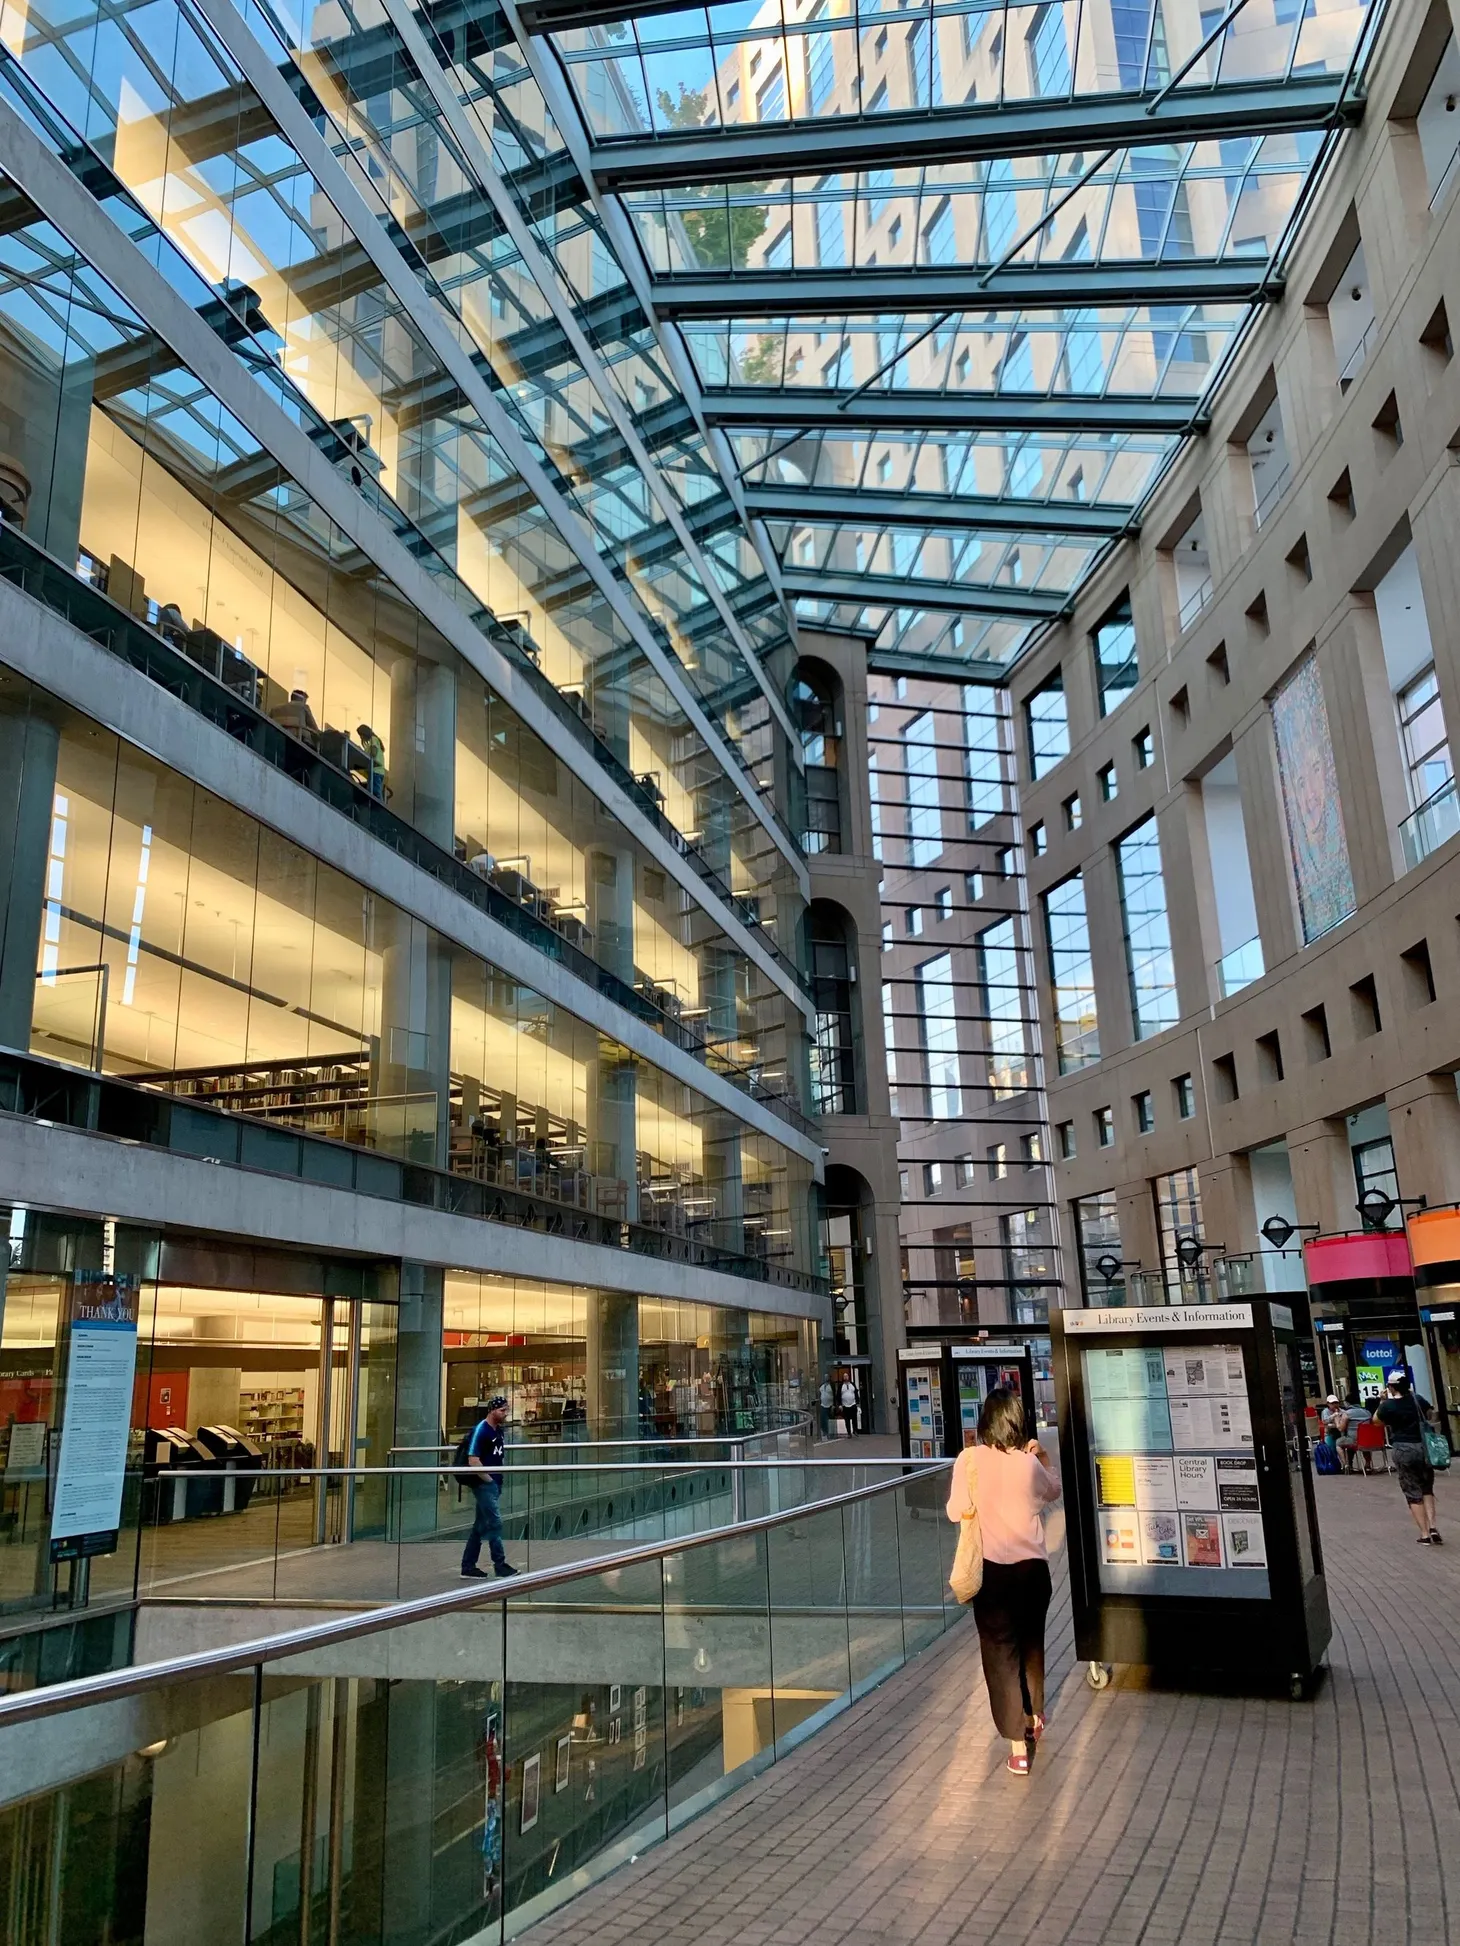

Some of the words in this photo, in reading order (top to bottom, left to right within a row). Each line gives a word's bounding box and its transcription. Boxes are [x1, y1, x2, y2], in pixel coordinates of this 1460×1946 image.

[80, 1305, 114, 1319] THANK
[115, 1307, 135, 1322] YOU
[1098, 1313, 1134, 1326] Library
[1136, 1312, 1170, 1323] Events
[1171, 1311, 1181, 1322] &
[1184, 1309, 1245, 1322] Information
[1179, 1465, 1207, 1473] Library
